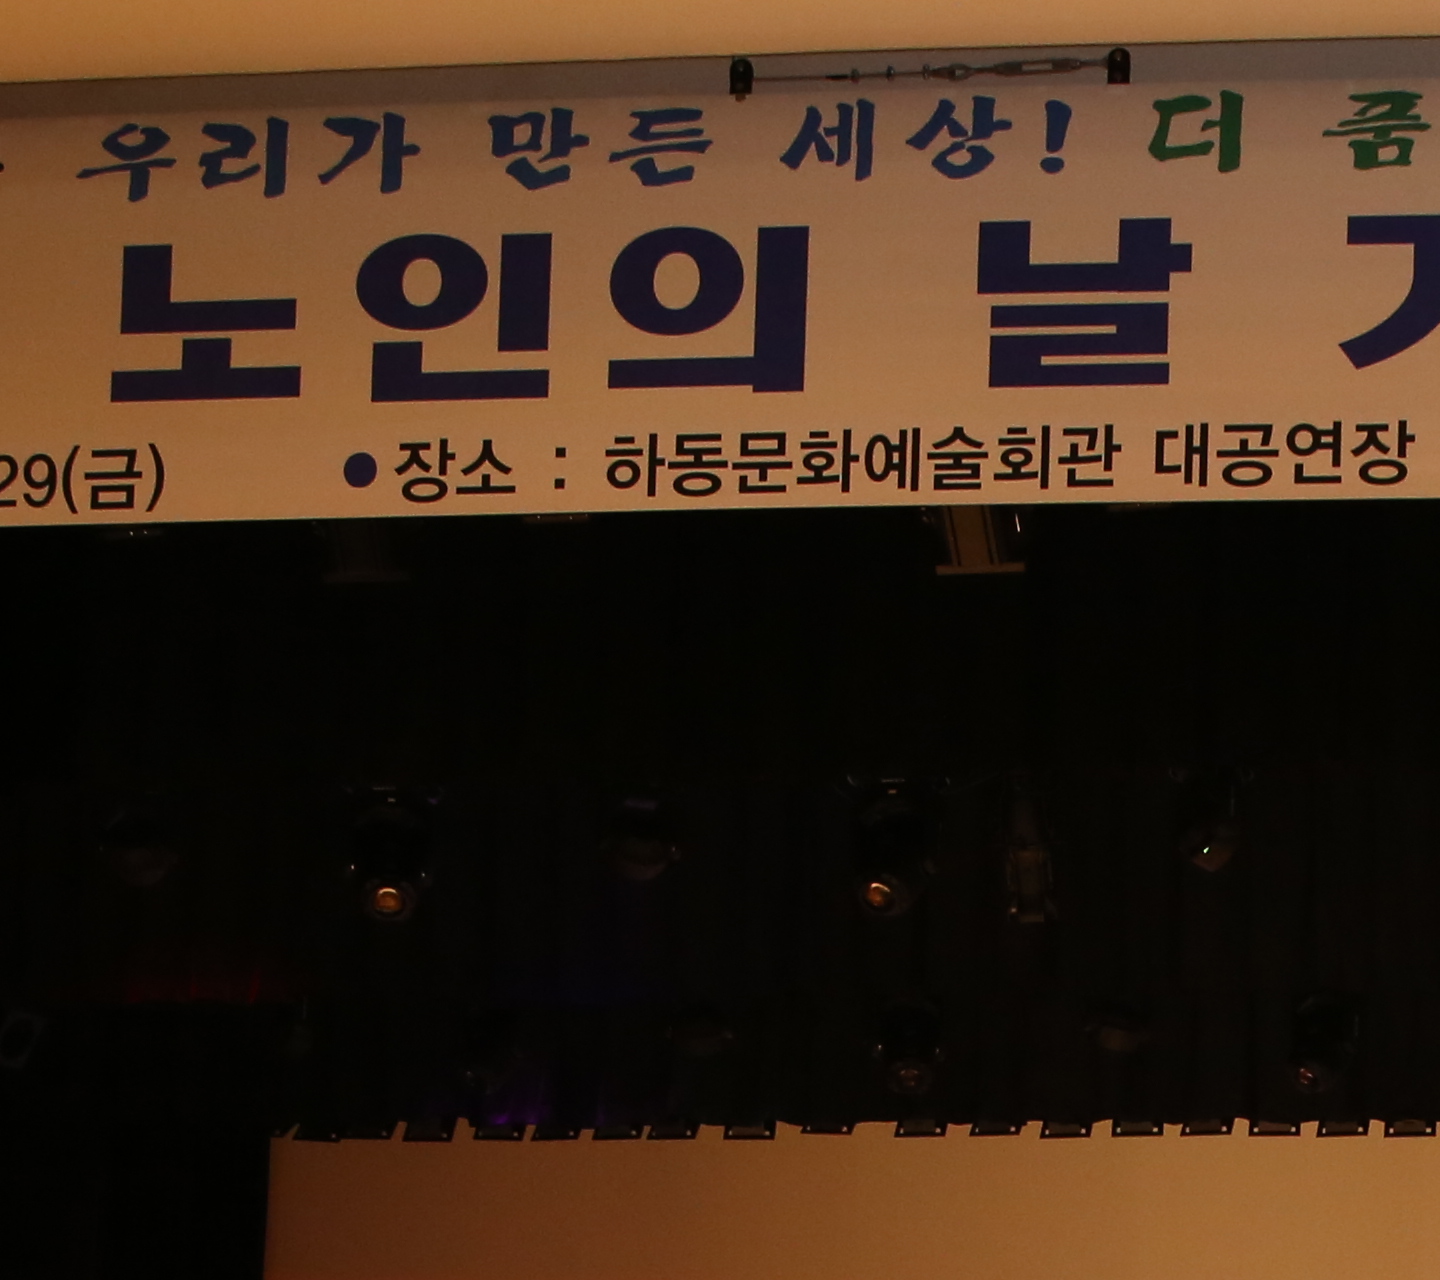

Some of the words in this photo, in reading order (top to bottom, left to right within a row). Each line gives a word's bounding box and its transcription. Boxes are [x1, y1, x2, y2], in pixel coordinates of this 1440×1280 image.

[76, 120, 422, 202] 우리가
[486, 105, 714, 190] 만든
[779, 97, 1072, 181] 세상!
[1146, 91, 1247, 173] 더
[111, 226, 809, 403] 노인의
[977, 218, 1192, 387] 날
[395, 439, 515, 503] 장소
[605, 425, 1121, 497] 하동문화예술회관
[1155, 420, 1415, 487] 대공연장
